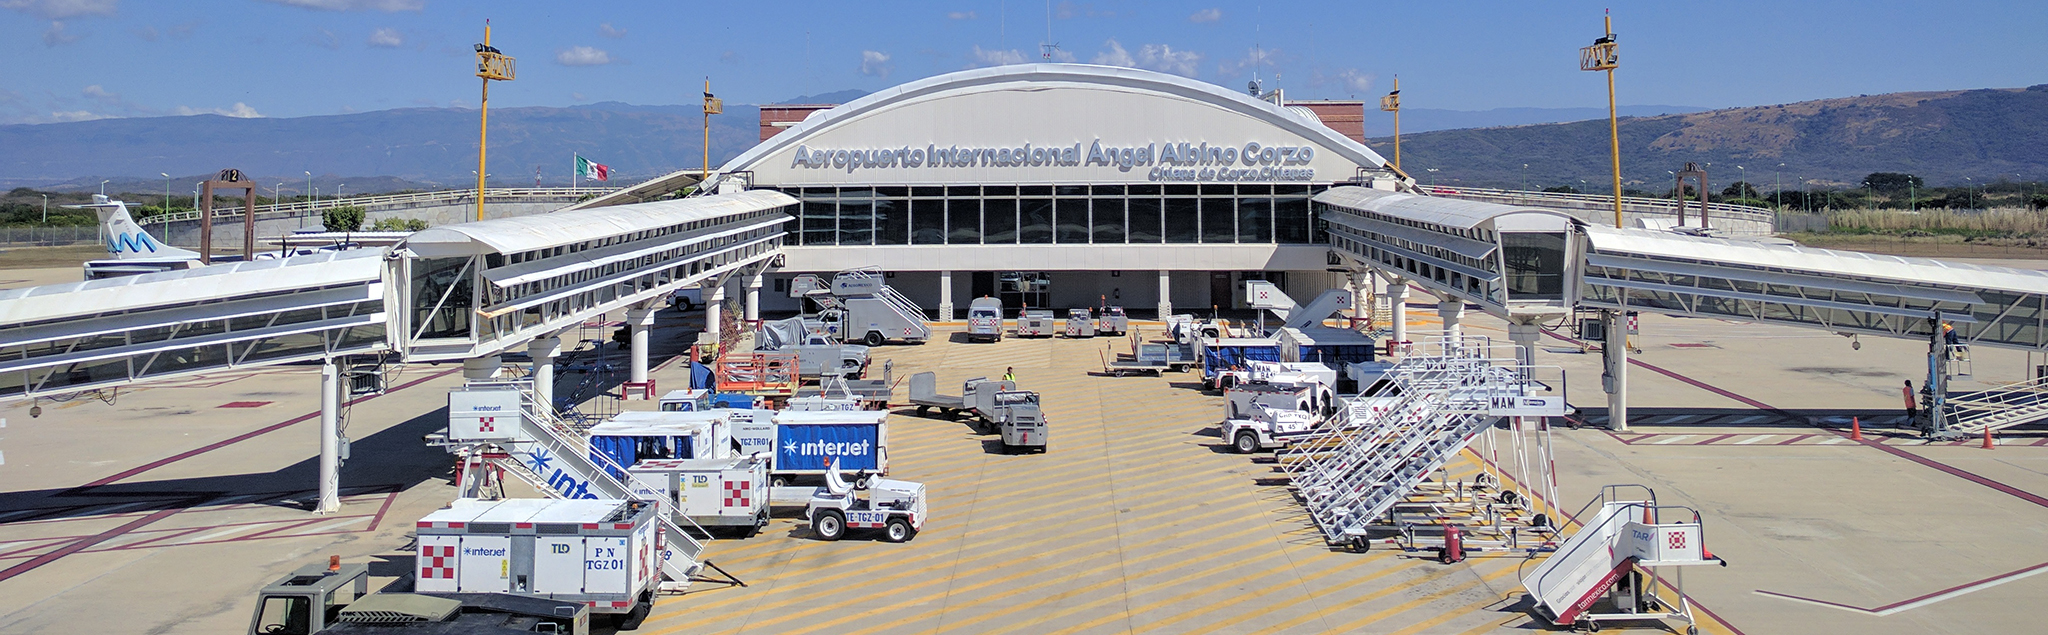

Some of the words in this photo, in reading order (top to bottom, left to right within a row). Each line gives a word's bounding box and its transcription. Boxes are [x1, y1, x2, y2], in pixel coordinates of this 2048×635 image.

[791, 144, 925, 174] Aeropuerto
[927, 143, 1081, 168] Internacional
[1084, 139, 1155, 172] Ángel
[1159, 142, 1238, 166] Albino
[1241, 142, 1314, 167] Corzo
[231, 169, 238, 181] 2
[1148, 166, 1197, 181] Chiapa
[1199, 166, 1217, 180] de
[841, 403, 854, 411] TGZ
[1491, 397, 1516, 409] MAM
[801, 439, 869, 456] interjet
[693, 475, 708, 483] TLD
[1633, 530, 1649, 541] TAR
[472, 547, 506, 557] interjet
[551, 543, 570, 554] TLD
